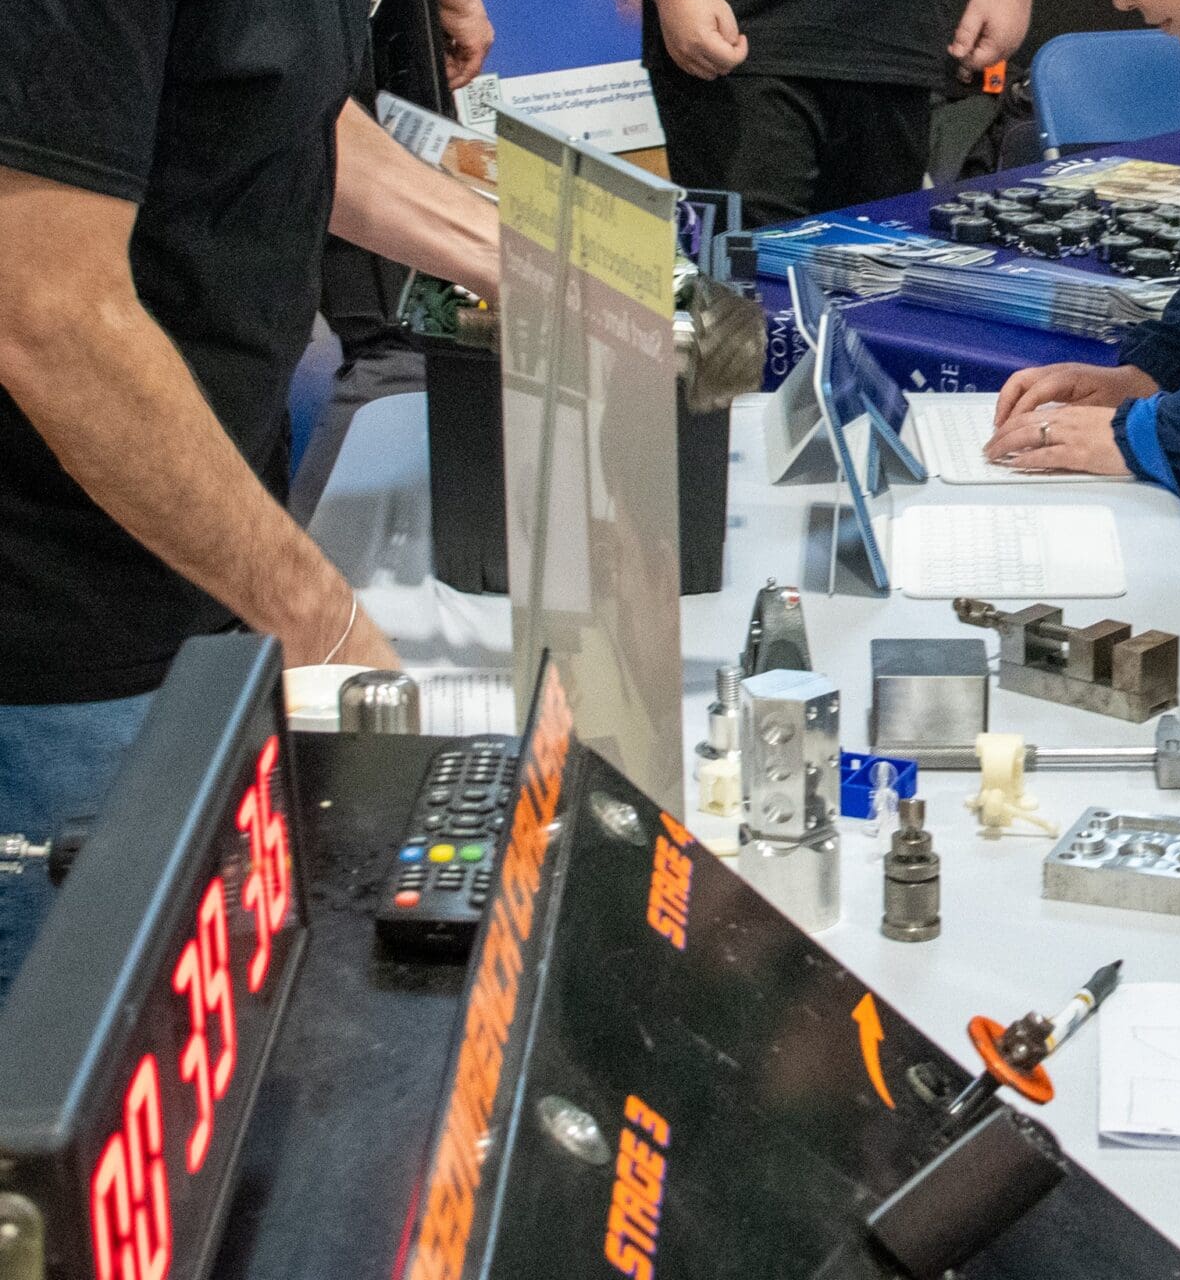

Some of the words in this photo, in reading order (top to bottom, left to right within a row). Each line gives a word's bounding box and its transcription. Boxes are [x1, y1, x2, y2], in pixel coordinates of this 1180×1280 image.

[659, 808, 697, 847] 4
[646, 834, 694, 951] STAGE
[624, 1094, 670, 1148] 3
[604, 1127, 666, 1280] STAGE
